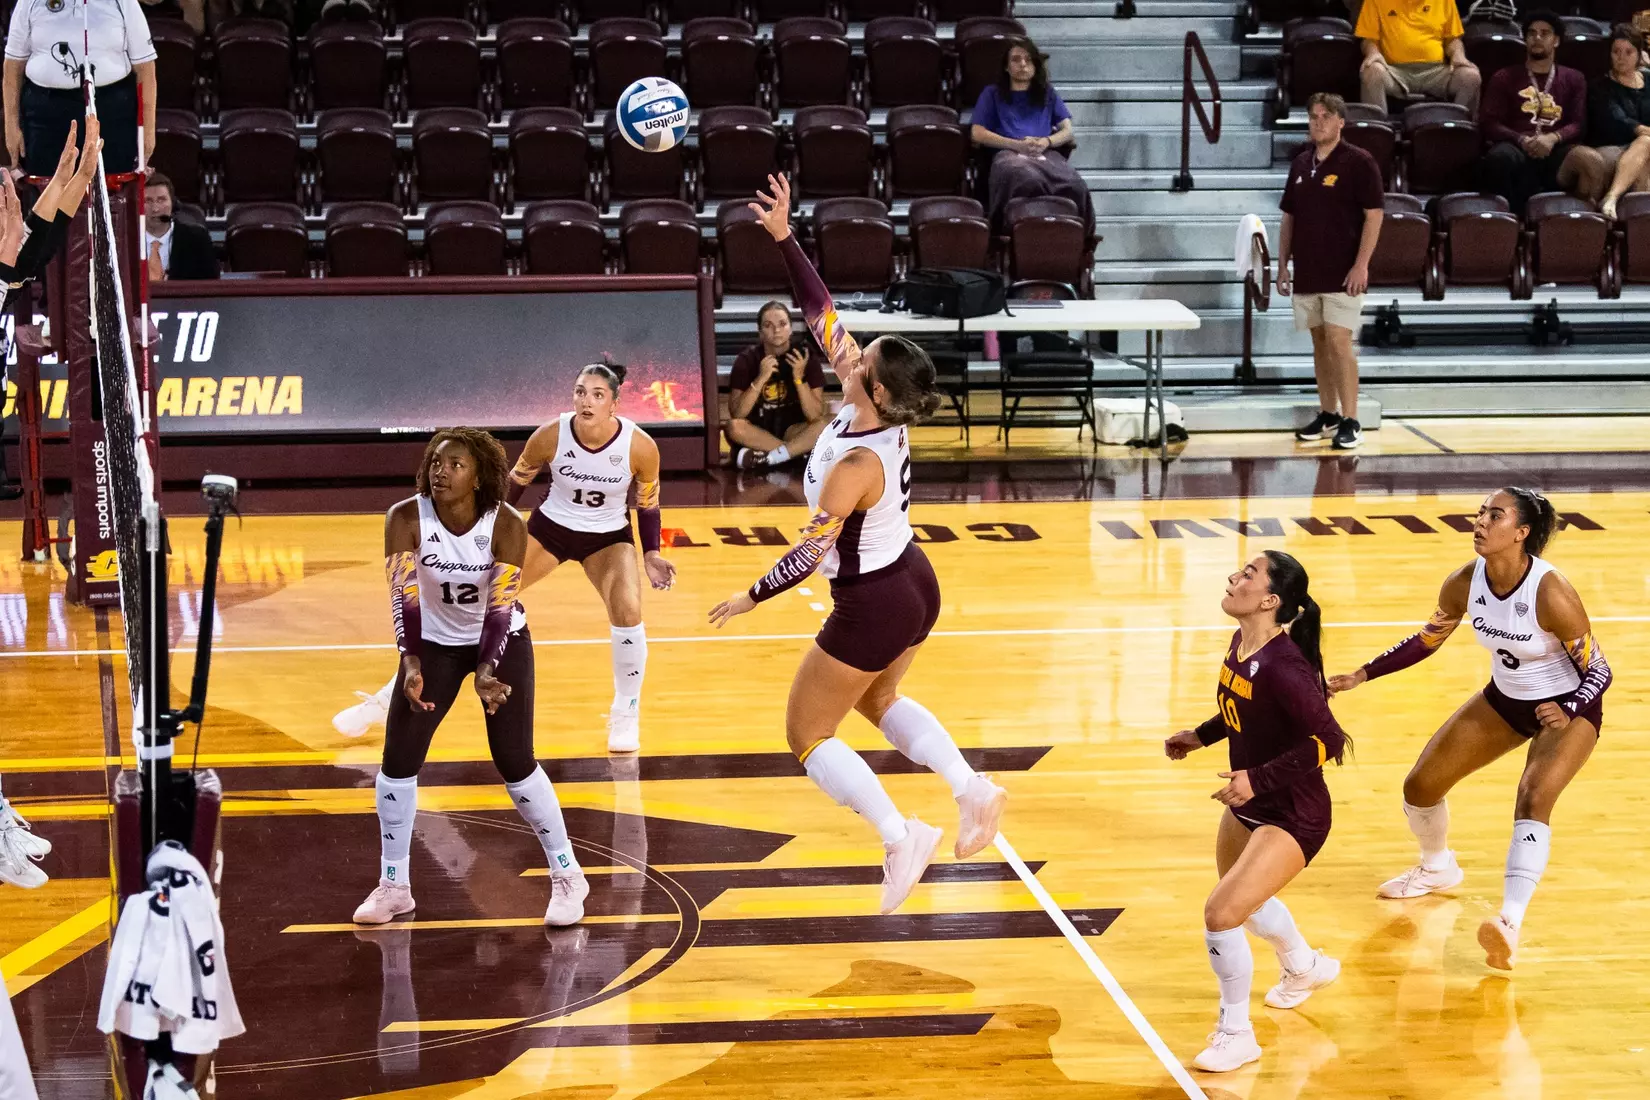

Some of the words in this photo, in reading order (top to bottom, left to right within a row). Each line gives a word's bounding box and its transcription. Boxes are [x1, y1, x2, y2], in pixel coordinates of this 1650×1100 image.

[645, 111, 684, 130] molten
[173, 311, 219, 362] TO
[157, 376, 303, 417] ARENA
[92, 440, 109, 485] sports
[559, 465, 623, 483] Chippewas
[96, 485, 112, 540] imports
[572, 488, 606, 508] 13
[765, 540, 824, 590] CHIPPEWAS
[440, 581, 479, 605] 12
[1472, 616, 1533, 642] Chippewas
[1496, 648, 1520, 670] 3
[1218, 692, 1241, 733] 10
